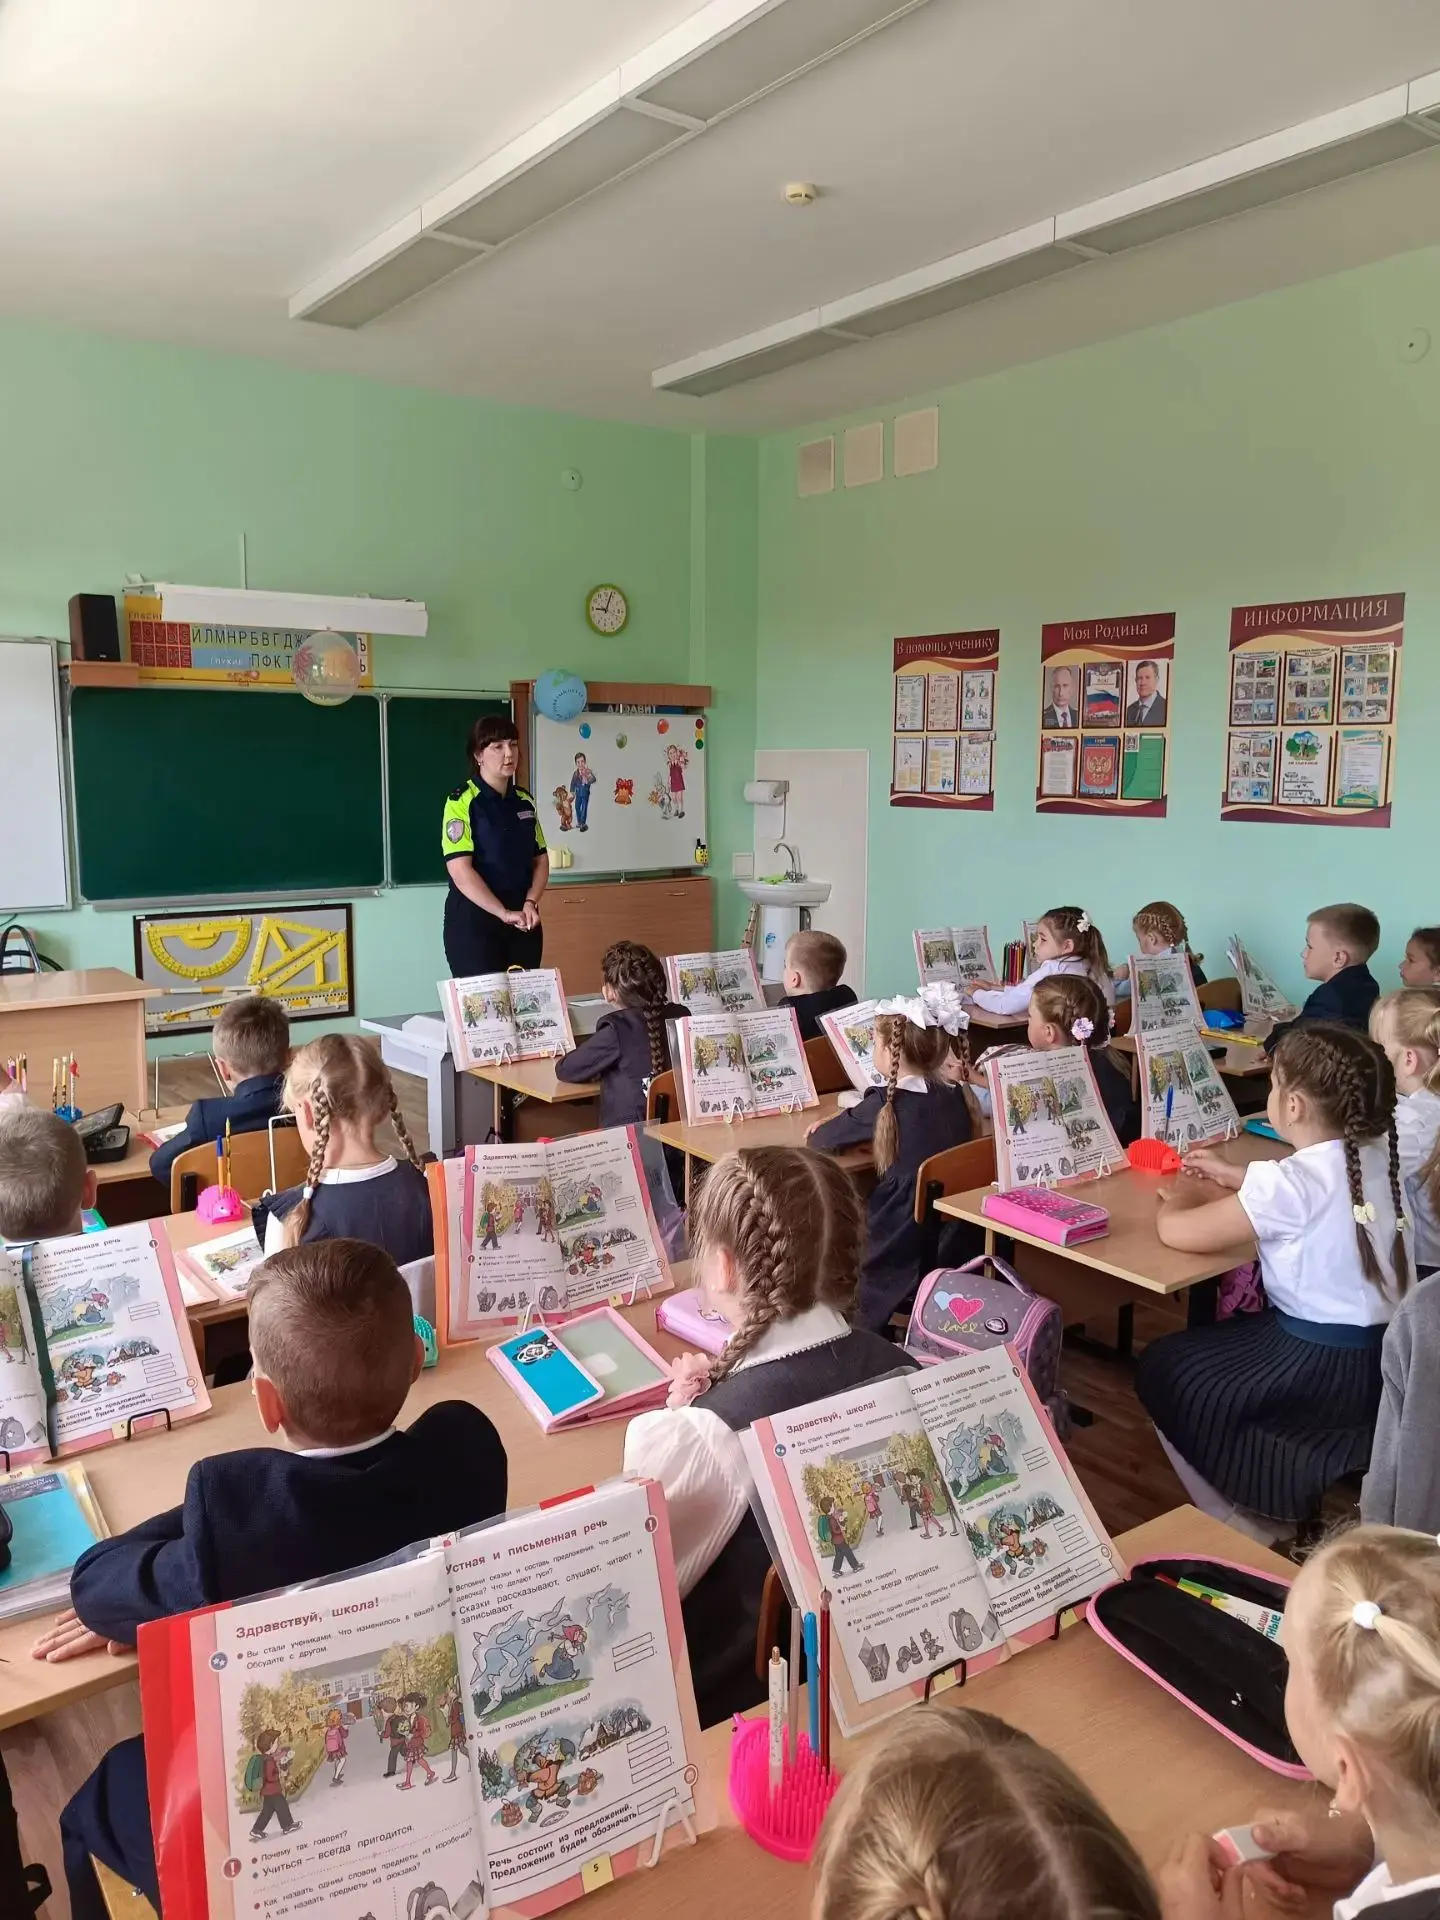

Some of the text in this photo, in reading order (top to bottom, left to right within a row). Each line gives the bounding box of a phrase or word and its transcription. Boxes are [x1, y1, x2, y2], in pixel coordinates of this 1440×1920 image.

[1244, 600, 1387, 626] ИНФОРМАЦИЯ
[359, 638, 366, 651] Ъ
[897, 638, 994, 654] В помощь ученику
[1064, 624, 1148, 640] Моя Родина
[360, 659, 365, 672] Ь
[911, 1383, 932, 1395] стная
[942, 1368, 976, 1384] письменная
[786, 1400, 876, 1433] Здравствуй, школа!
[445, 1519, 608, 1575] Устная и письменная речь
[455, 1577, 486, 1592] Вспомни
[489, 1570, 512, 1581] сказки
[524, 1560, 550, 1572] составь
[456, 1587, 487, 1603] девочка?
[507, 1576, 532, 1588] делают
[535, 1568, 554, 1579] гуси?
[459, 1600, 490, 1614] Сказки
[496, 1579, 560, 1605] рассказывают,
[566, 1565, 602, 1583] слушают,
[606, 1553, 633, 1566] читают
[995, 1596, 1035, 1617] Предложение
[1009, 1589, 1031, 1602] состоит
[235, 1597, 380, 1639] Здравствуй, школа!
[461, 1603, 514, 1625] записывают.
[247, 1649, 259, 1658] Вы
[263, 1643, 287, 1655] стали
[290, 1633, 332, 1650] учениками.
[338, 1627, 352, 1637] Что
[356, 1617, 401, 1633] изменилось
[246, 1655, 285, 1670] Обсудите
[299, 1645, 329, 1659] другом.
[476, 1731, 483, 1739] О
[505, 1715, 537, 1730] говорили
[540, 1706, 561, 1718] Емеля
[261, 1829, 348, 1861] Почему так говорят?
[262, 1858, 302, 1876] Учиться
[318, 1844, 351, 1861] всегда
[357, 1824, 414, 1849] пригодится.
[489, 1803, 633, 1869] Речь состоит из предложений.
[490, 1811, 637, 1880] Предложение будем обозначать
[263, 1898, 278, 1907] Как
[282, 1886, 314, 1901] назвать
[318, 1876, 344, 1889] одним
[348, 1867, 377, 1881] словом
[381, 1853, 418, 1871] предметы
[422, 1848, 431, 1856] из
[592, 1863, 600, 1872] 5
[265, 1862, 421, 1919] А как назвать предметы из рюкзака?
